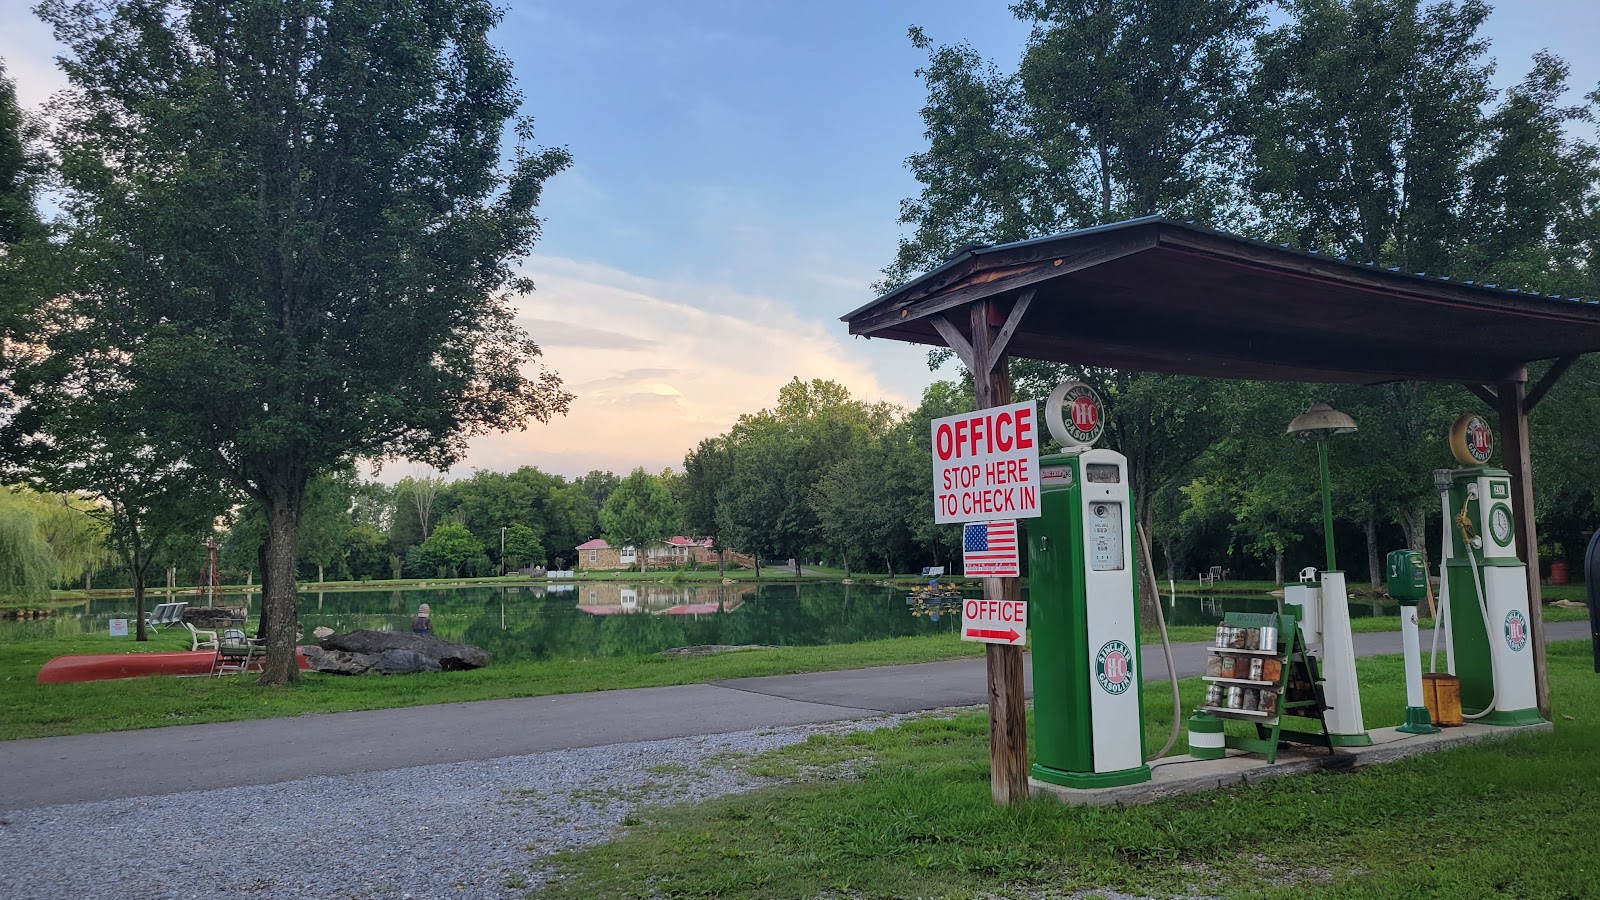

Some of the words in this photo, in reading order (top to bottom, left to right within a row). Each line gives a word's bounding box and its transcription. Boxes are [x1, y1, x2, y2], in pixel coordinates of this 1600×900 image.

[936, 408, 1033, 461] OFFICE
[943, 464, 981, 491] STOP
[985, 458, 1029, 486] HERE
[938, 493, 958, 517] TO
[962, 487, 1016, 515] CHECK
[1019, 485, 1036, 511] IN
[965, 600, 1024, 623] OFFICE
[1237, 614, 1264, 623] MOTOR
[1098, 642, 1131, 664] SINCLAIR
[1099, 671, 1132, 693] GASOLINE
